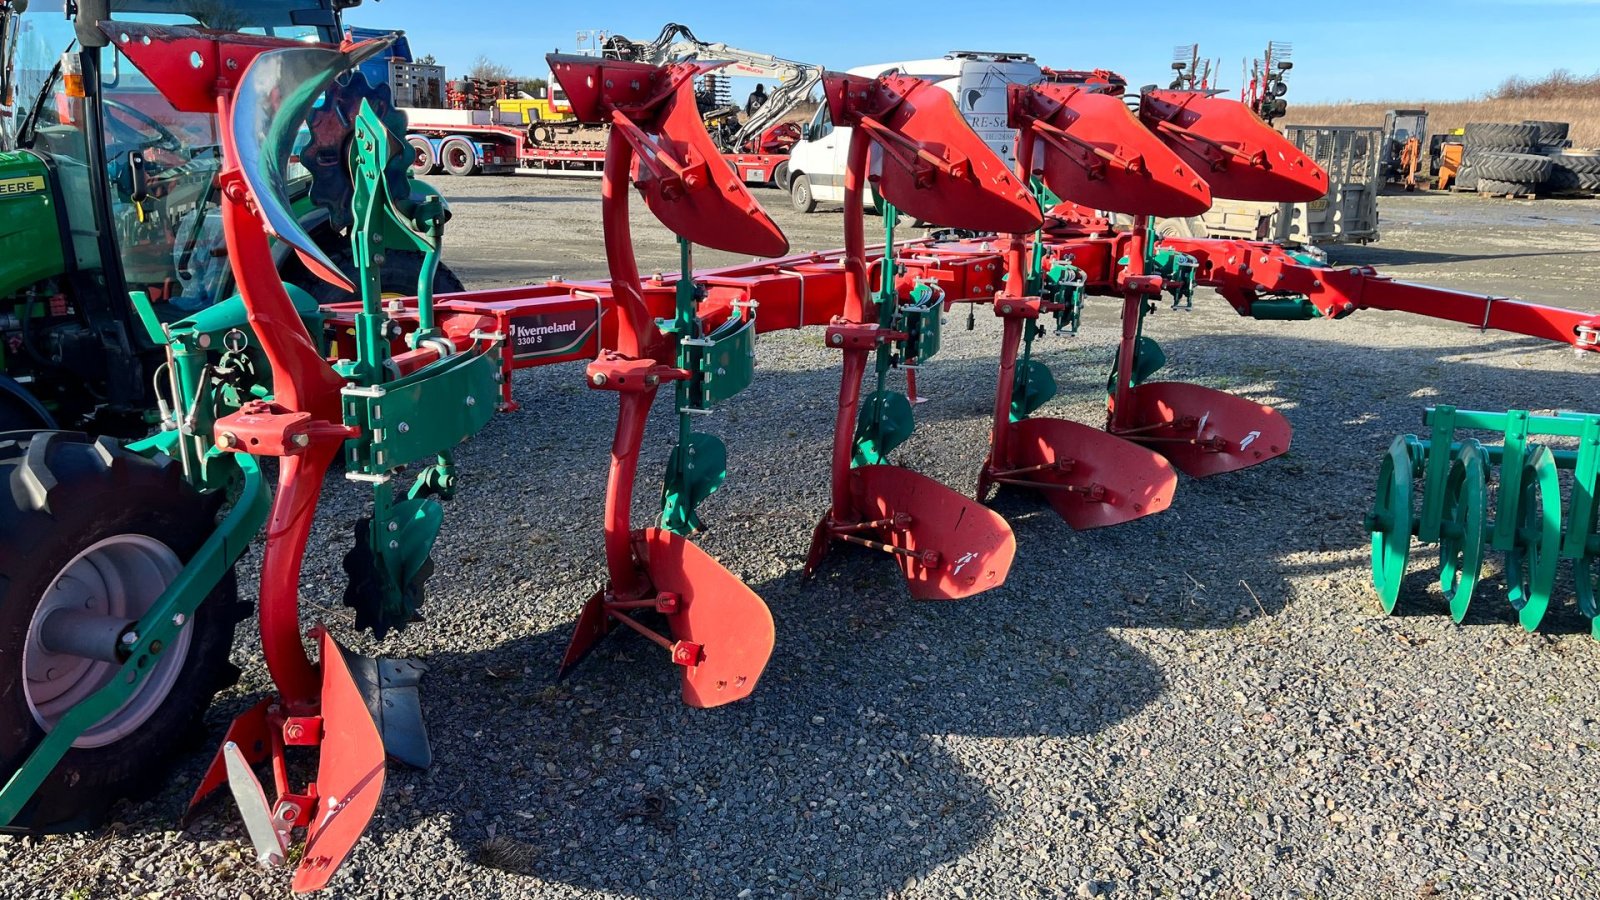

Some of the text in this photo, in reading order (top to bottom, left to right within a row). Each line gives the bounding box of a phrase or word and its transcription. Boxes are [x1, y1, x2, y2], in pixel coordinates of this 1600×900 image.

[972, 116, 1008, 128] RE-Se
[517, 320, 576, 337] Kverneland
[517, 335, 543, 346] 3300 S
